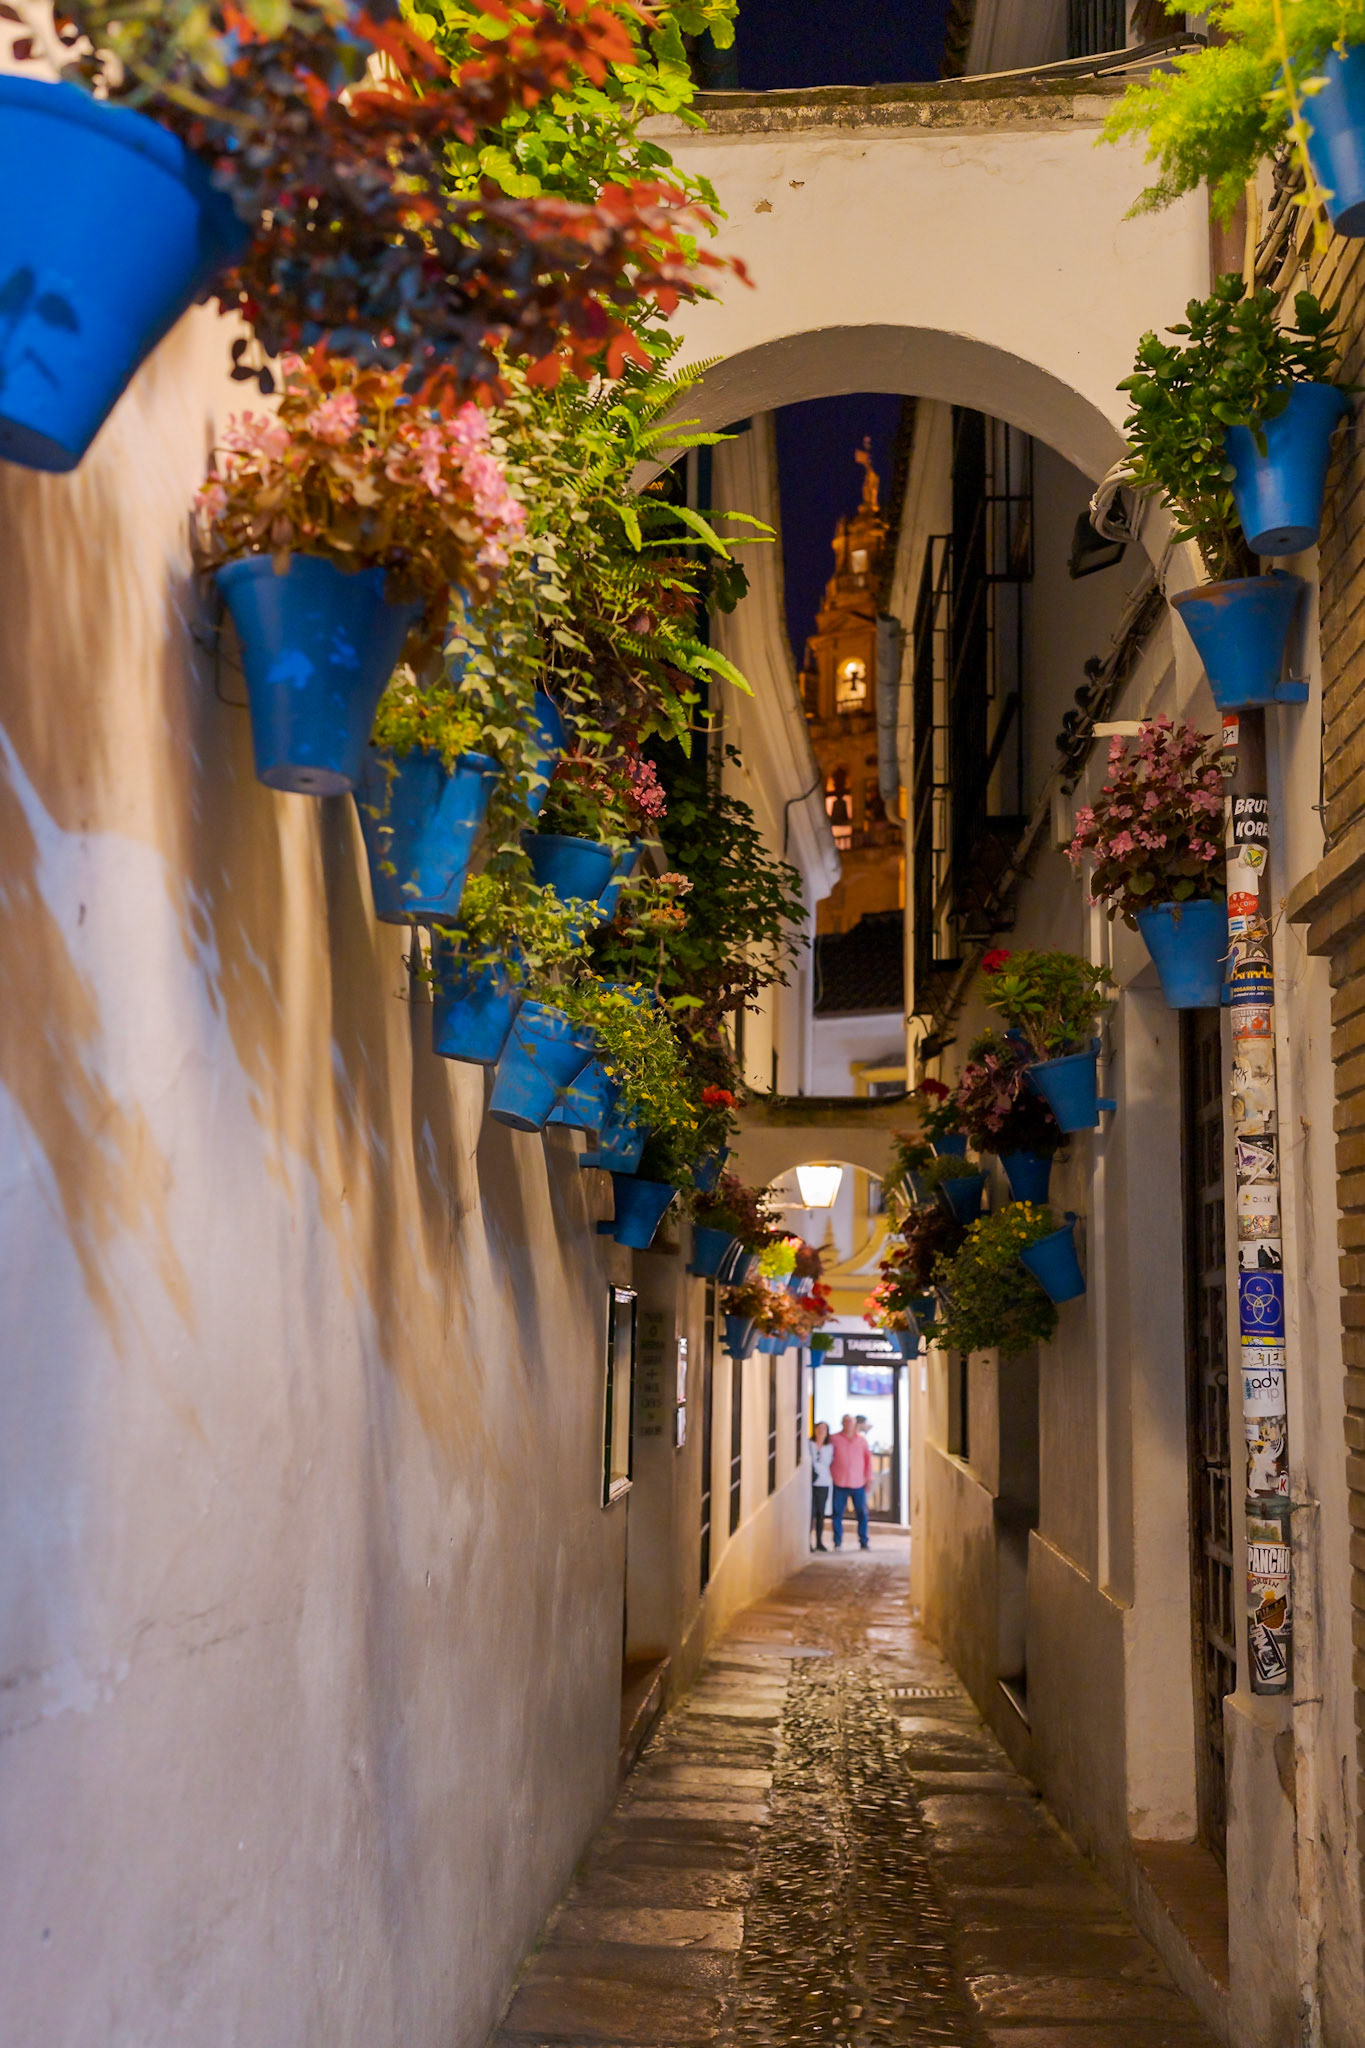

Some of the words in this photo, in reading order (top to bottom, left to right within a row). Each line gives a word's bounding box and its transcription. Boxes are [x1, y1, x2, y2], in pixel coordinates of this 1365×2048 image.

[1252, 1371, 1280, 1389] adv
[1253, 1387, 1280, 1402] trip
[1247, 1547, 1290, 1575] PANCHO
